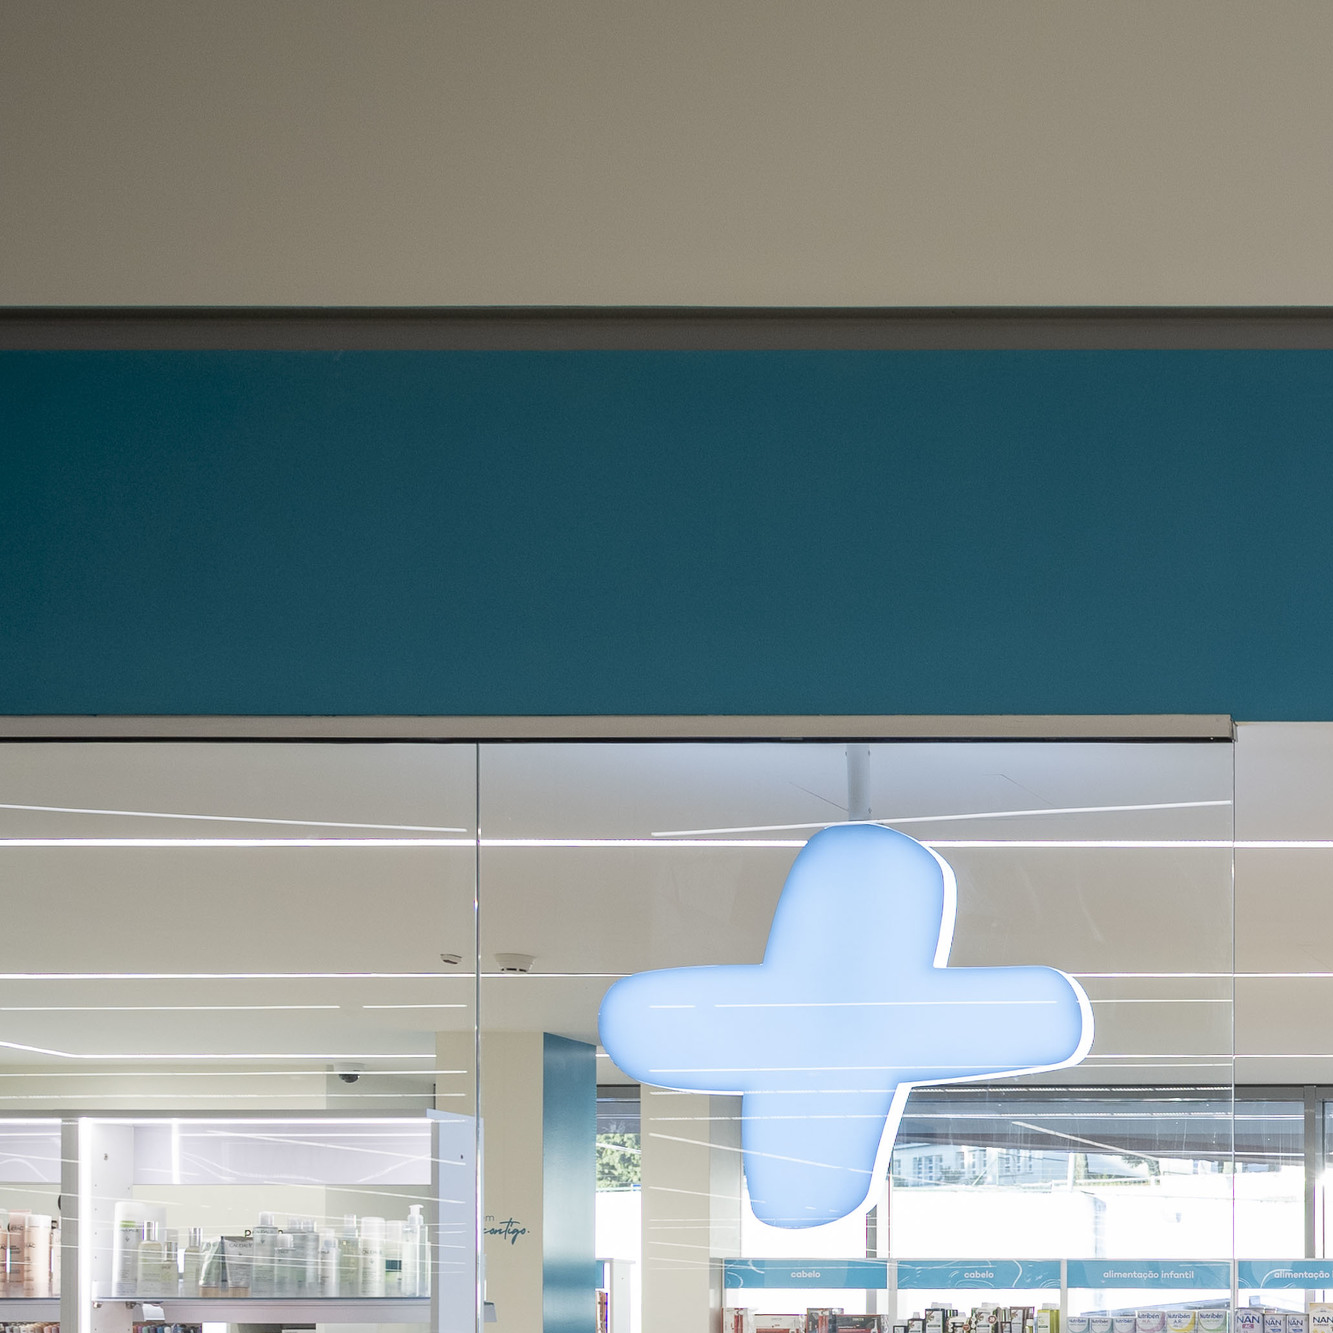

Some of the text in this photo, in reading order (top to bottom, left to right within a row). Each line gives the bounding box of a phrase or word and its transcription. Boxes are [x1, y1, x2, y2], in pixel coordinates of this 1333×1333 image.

[790, 1269, 821, 1279] cabelo
[963, 1269, 994, 1279] cabelo
[1102, 1270, 1195, 1280] alimentação infantil
[1273, 1270, 1330, 1280] alimentação
[1236, 1315, 1260, 1324] NAN
